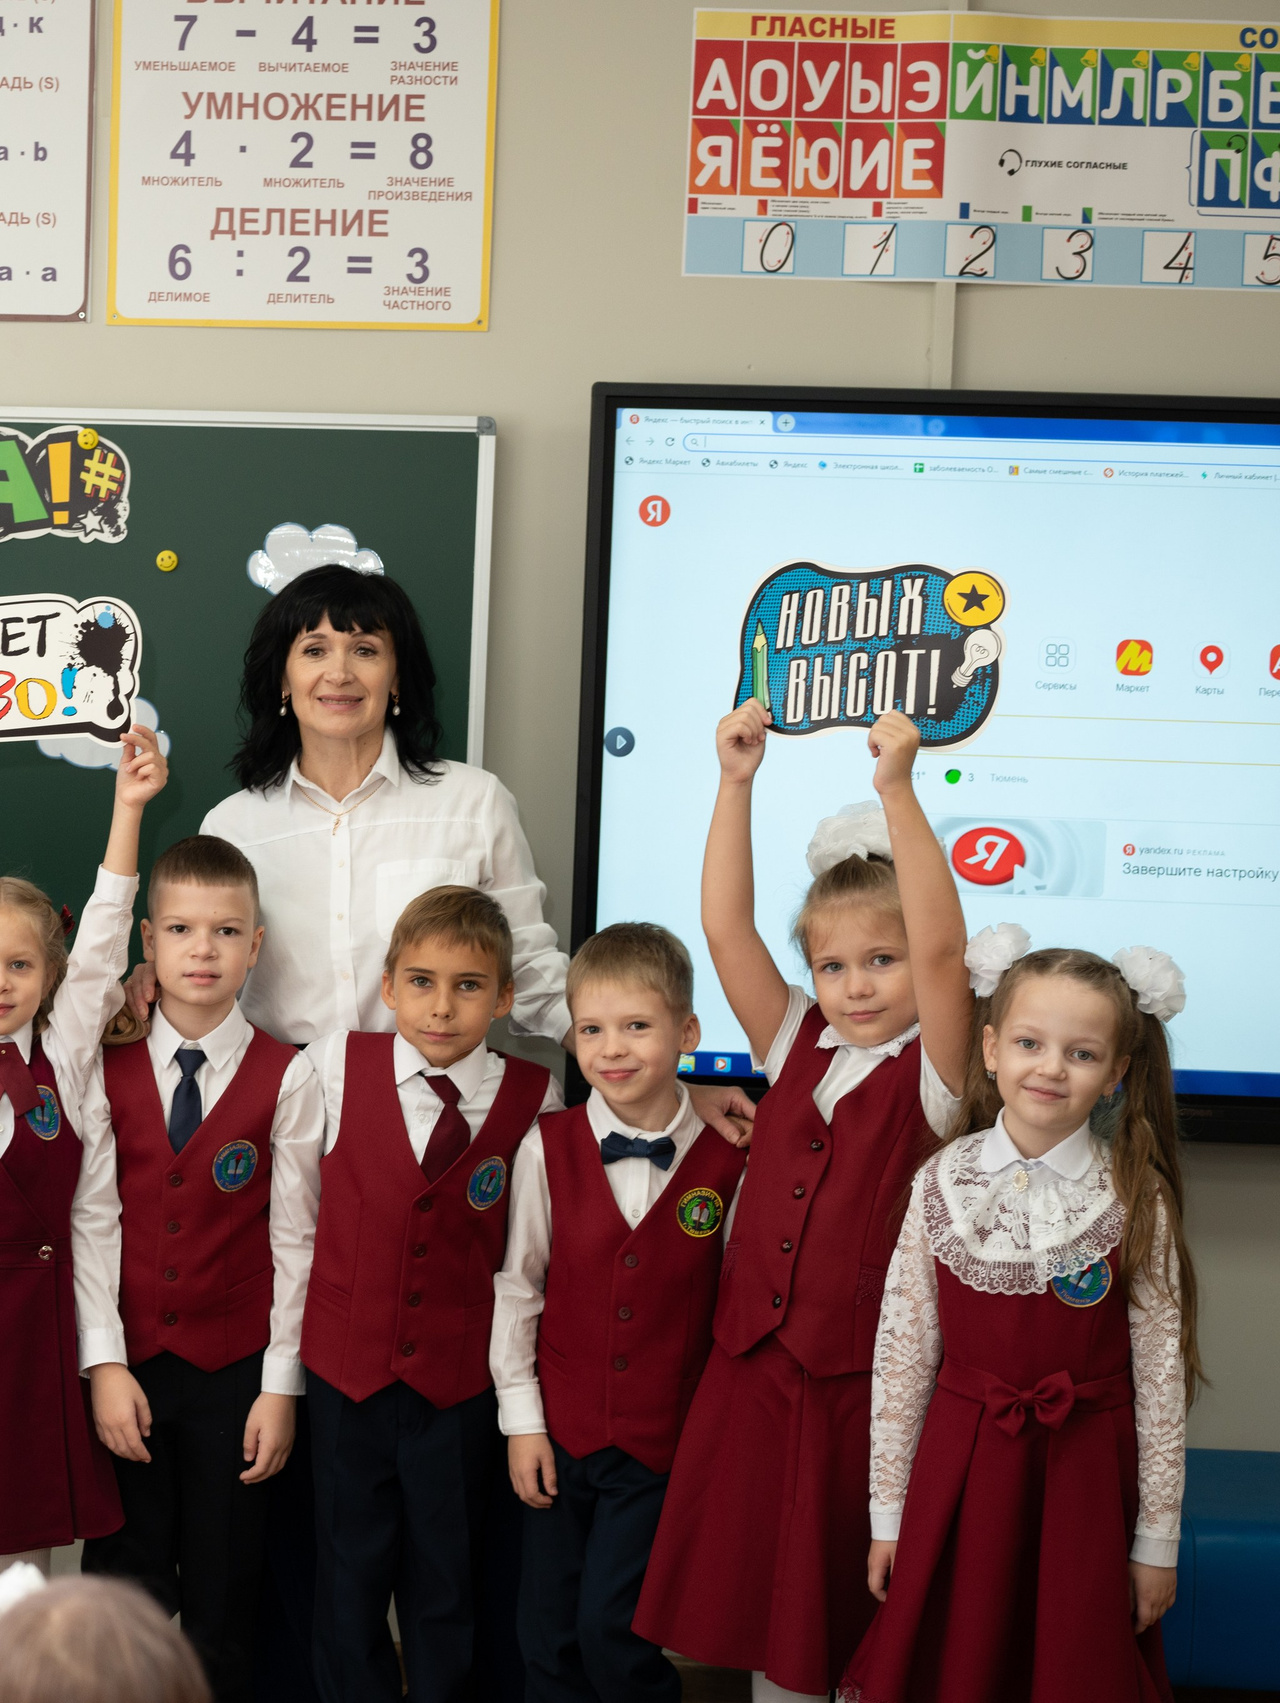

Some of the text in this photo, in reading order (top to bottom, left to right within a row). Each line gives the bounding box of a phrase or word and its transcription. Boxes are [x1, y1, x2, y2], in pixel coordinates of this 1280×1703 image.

[750, 16, 896, 39] ГЛАСНЫЕ
[174, 15, 197, 51] 7
[292, 16, 317, 52] 4
[354, 26, 379, 43] =
[413, 17, 437, 54] 3
[135, 61, 235, 71] УМЕНЬШАЕМОЕ
[259, 62, 349, 73] ВЫЧИТАЕМОЕ
[391, 61, 458, 71] ЗНАЧЕНИЕ
[390, 75, 458, 85] РАЗНОСТИ
[182, 92, 425, 122] УМНОЖЕНИЕ
[170, 130, 195, 166] 4
[289, 132, 314, 168] 2
[350, 142, 376, 159] =
[410, 133, 433, 170] 8
[1025, 160, 1127, 170] ГЛУХИЕ СОГЛАСНЫЕ
[142, 176, 222, 186] МНОЖИТЕЛЬ
[264, 178, 344, 188] МНОЖИТЕЛЬ
[387, 177, 454, 187] ЗНАЧЕНИЕ
[368, 191, 472, 202] ПРОИЗВЕДЕНИЯ
[210, 208, 389, 240] ДЕЛЕНИЕ
[168, 244, 192, 281] 6
[286, 246, 310, 282] 2
[347, 256, 372, 274] =
[406, 247, 429, 284] 3
[383, 286, 451, 297] ЗНАЧЕНИЕ
[148, 292, 210, 303] ДЕЛИМОЕ
[267, 293, 335, 304] ДЕЛИТЕЛЬ
[383, 300, 451, 311] ЧАСТНОГО
[776, 577, 927, 651] НОВЫХ
[785, 648, 941, 725] ВЫСОТ!
[1035, 681, 1077, 691] Сервисы
[1116, 683, 1150, 693] Маркет
[1195, 686, 1224, 696] Карты
[969, 773, 975, 782] 3
[990, 773, 1028, 784] Тюмень
[1139, 845, 1184, 856] yandex.ru
[1122, 862, 1279, 882] Завершите настройку
